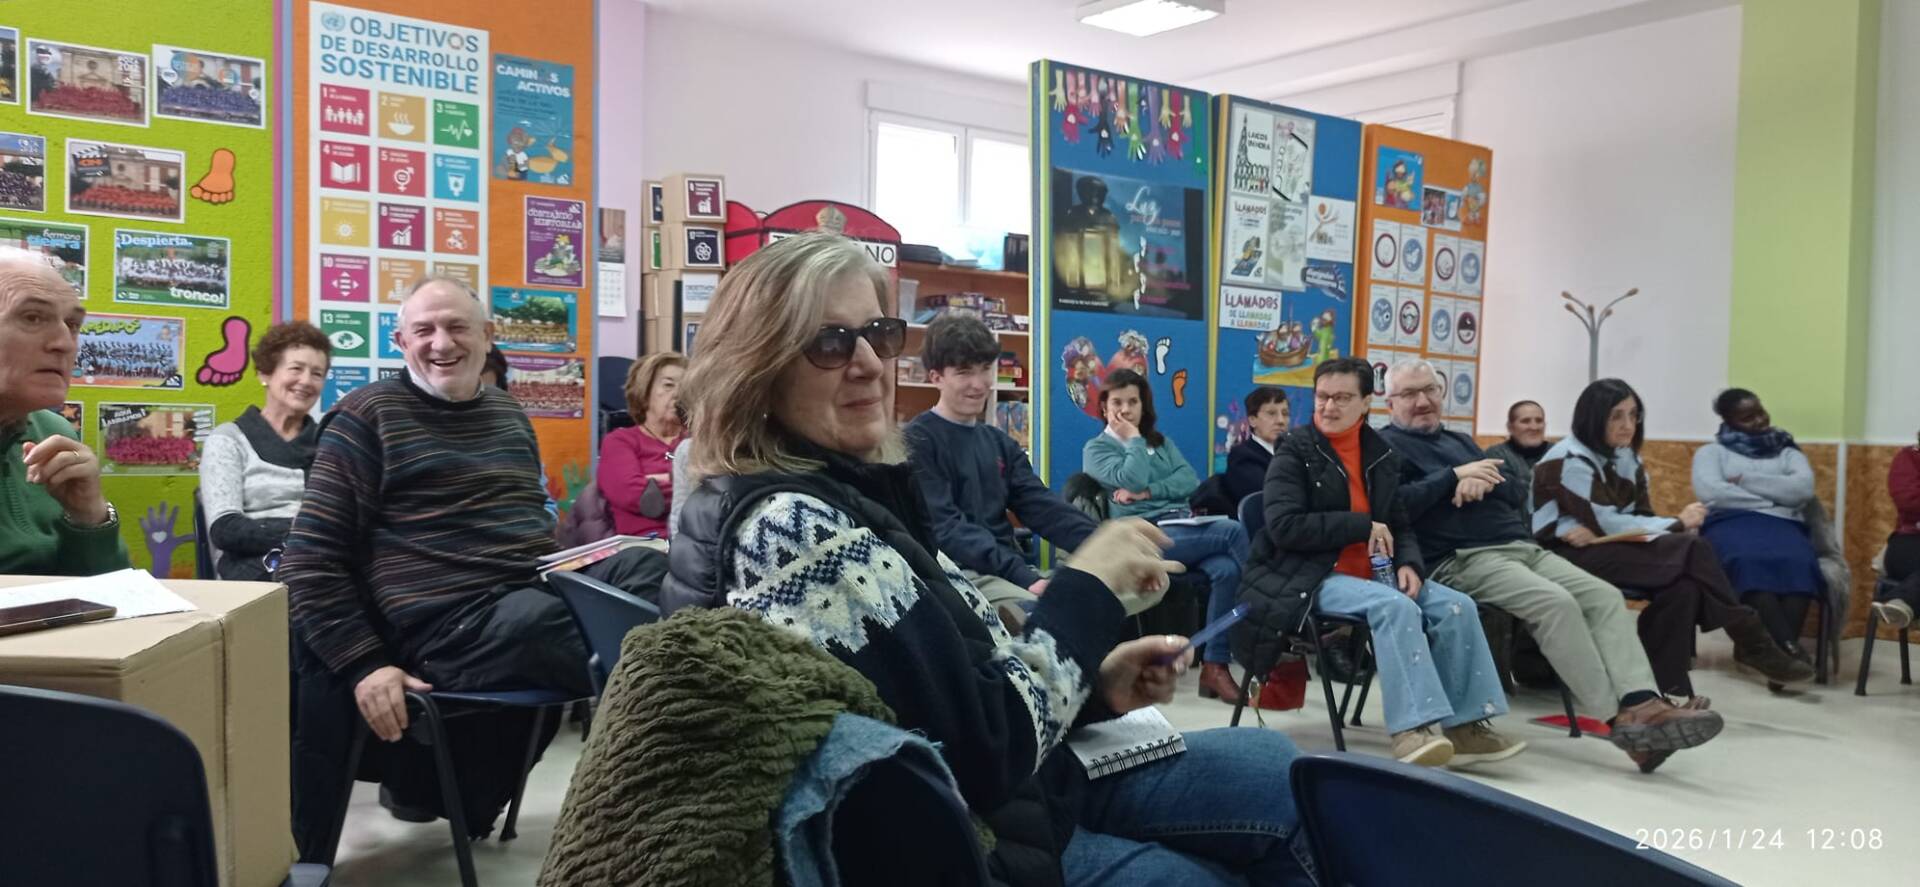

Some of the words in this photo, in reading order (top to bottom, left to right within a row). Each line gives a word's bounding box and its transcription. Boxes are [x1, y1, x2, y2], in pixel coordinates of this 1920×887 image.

[350, 16, 479, 53] OBJETIVOS
[320, 34, 346, 52] DE
[353, 38, 479, 73] DESARROLLO
[321, 53, 479, 95] SOSTENIBLE
[322, 87, 328, 98] 1
[517, 80, 571, 98] ACTIVOS
[381, 95, 388, 106] 2
[436, 103, 443, 113] 3
[323, 144, 330, 155] 4
[381, 151, 387, 161] 5
[436, 156, 443, 167] 6
[380, 206, 388, 216] 8
[322, 256, 333, 268] 10
[169, 286, 224, 304] tronco!
[322, 313, 333, 323] 13
